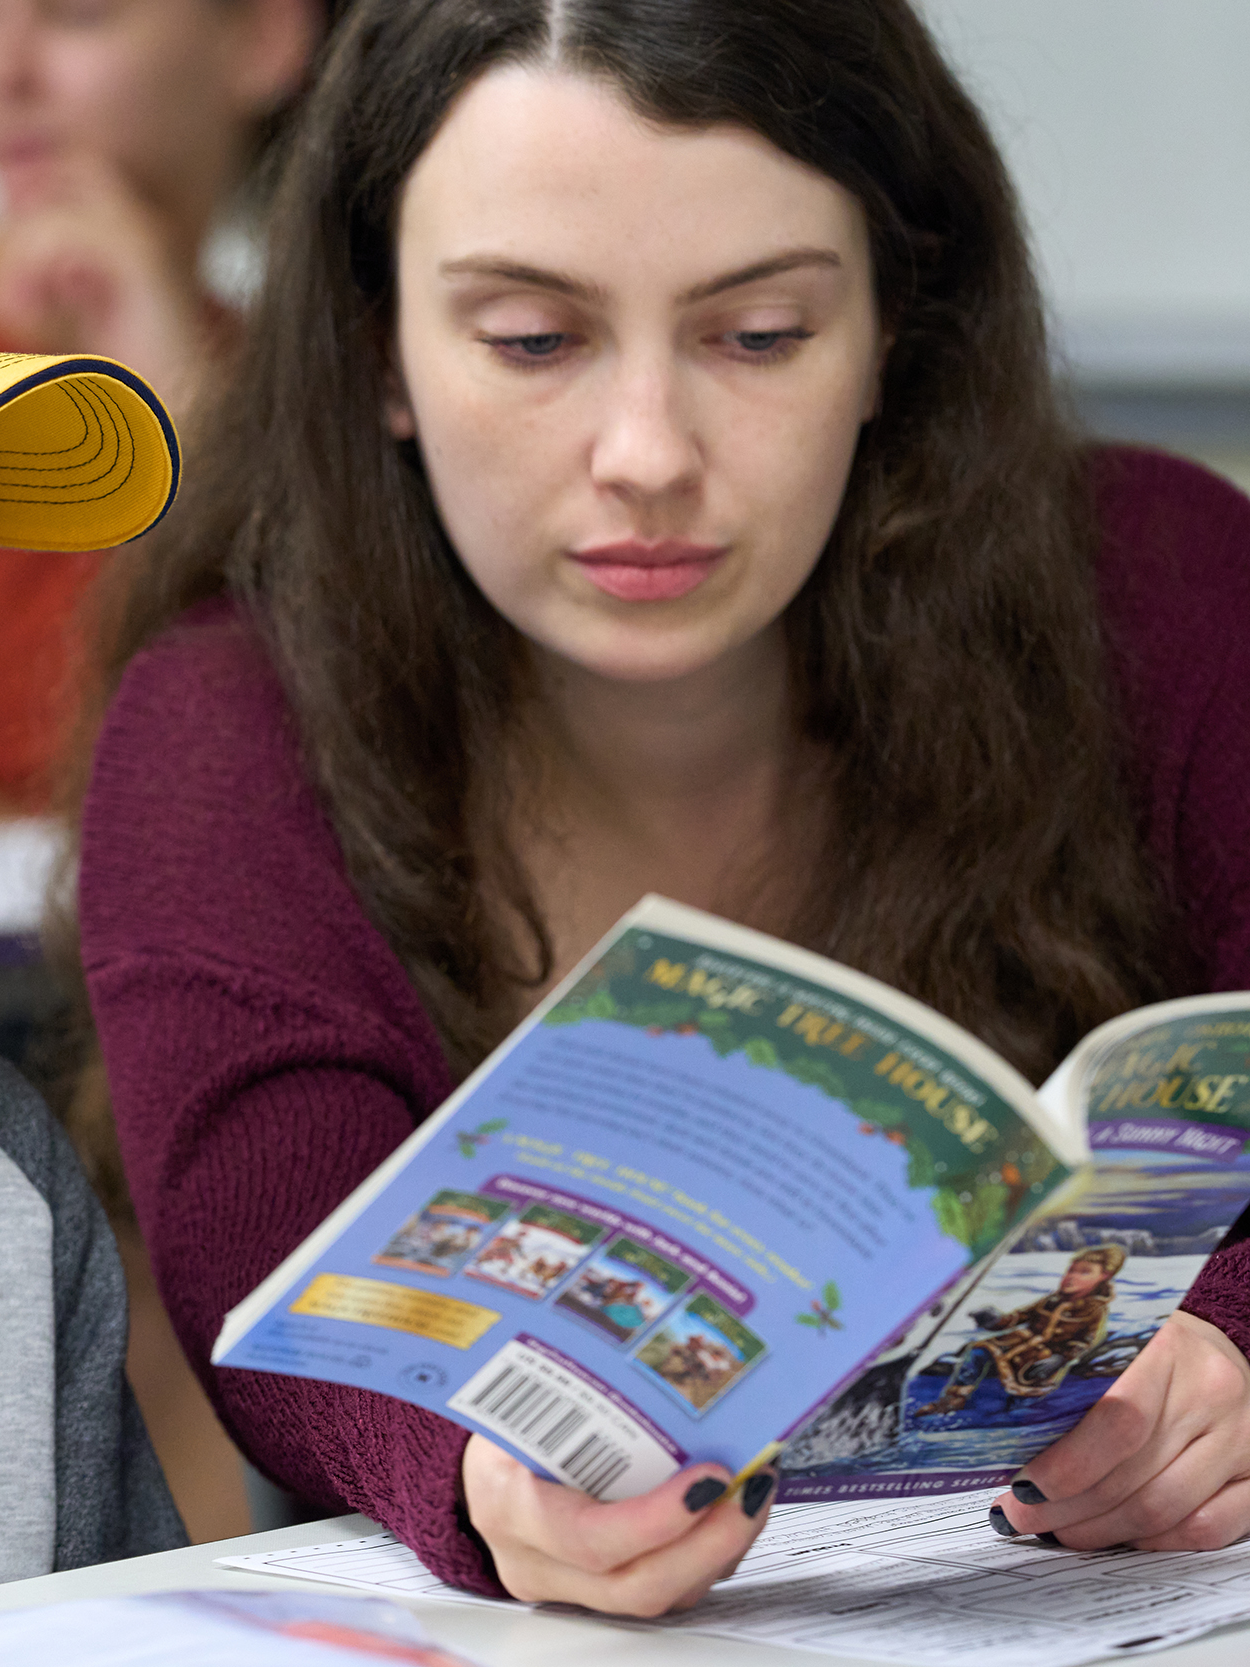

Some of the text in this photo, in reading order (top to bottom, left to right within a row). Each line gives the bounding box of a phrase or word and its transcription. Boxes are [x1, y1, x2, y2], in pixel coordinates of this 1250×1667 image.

[643, 957, 772, 1017] MAGIC
[776, 1000, 868, 1062] TREE
[873, 1051, 999, 1154] HOUSE
[837, 1479, 945, 1495] BESTSELLING
[950, 1474, 1007, 1489] SERIES
